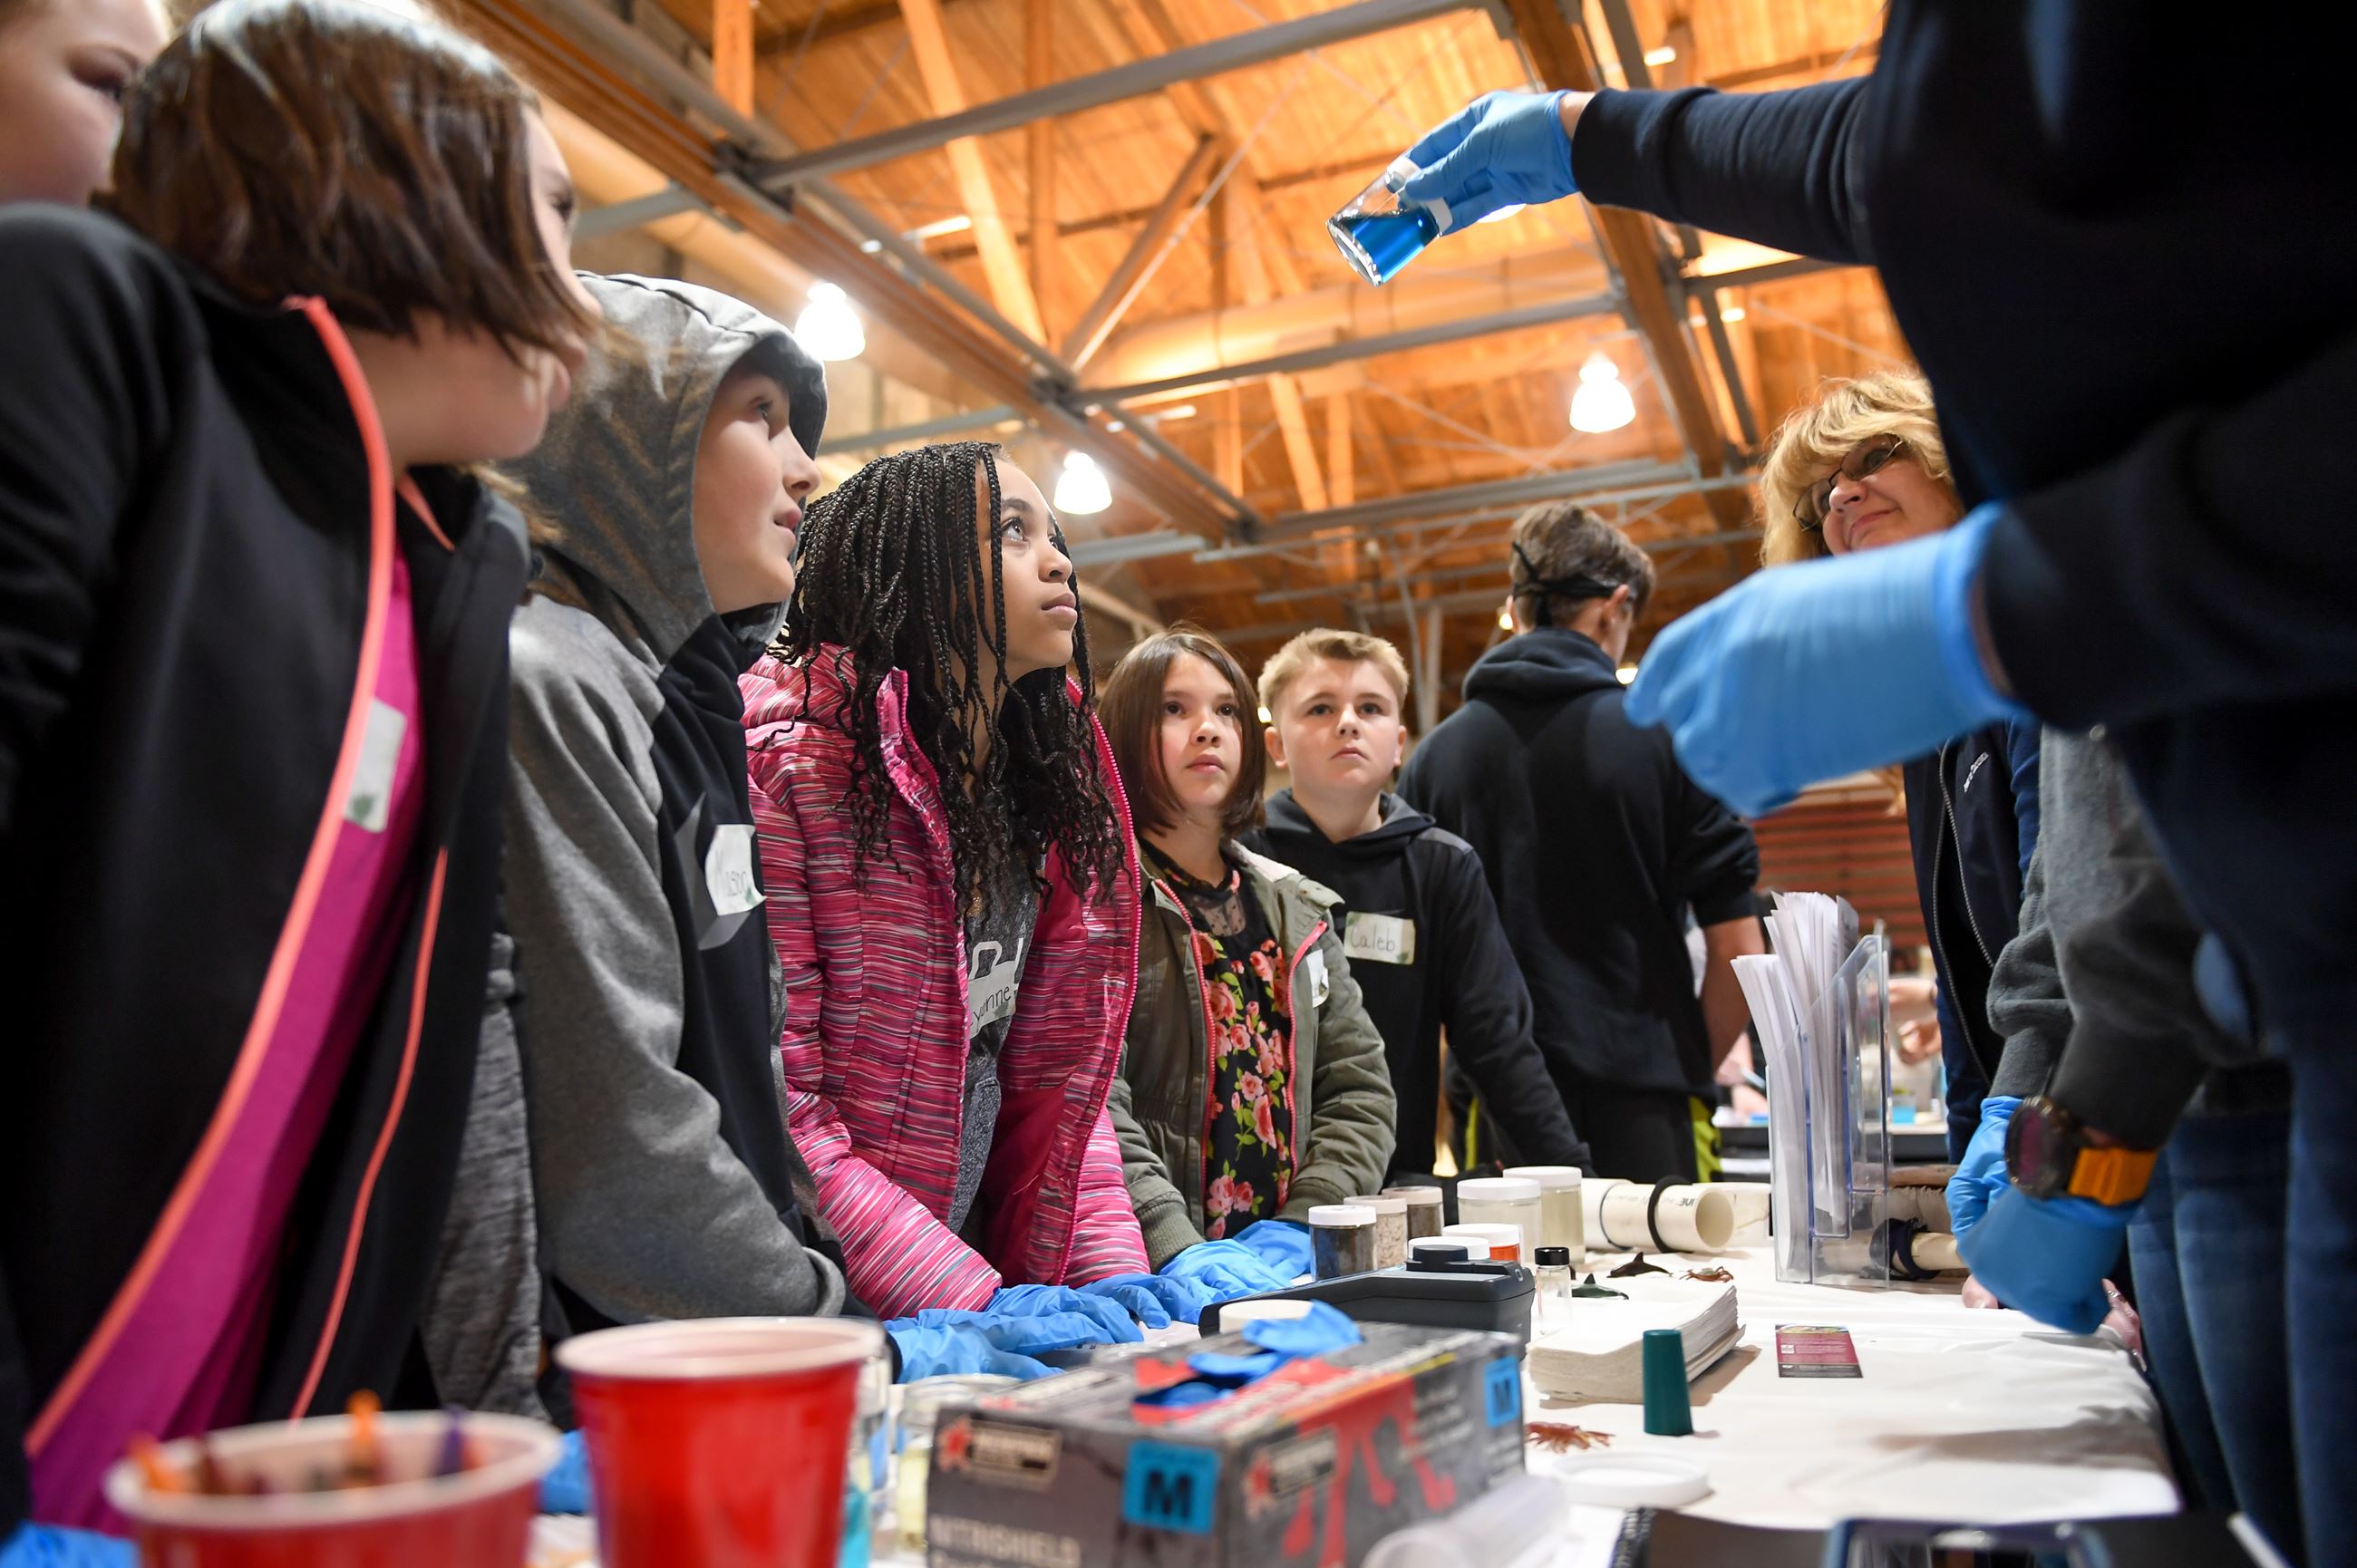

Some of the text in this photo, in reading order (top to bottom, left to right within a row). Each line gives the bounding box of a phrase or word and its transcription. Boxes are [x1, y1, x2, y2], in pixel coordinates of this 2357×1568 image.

[1350, 924, 1396, 952] Caleb
[1492, 1377, 1512, 1417] M
[1144, 1469, 1194, 1521] M
